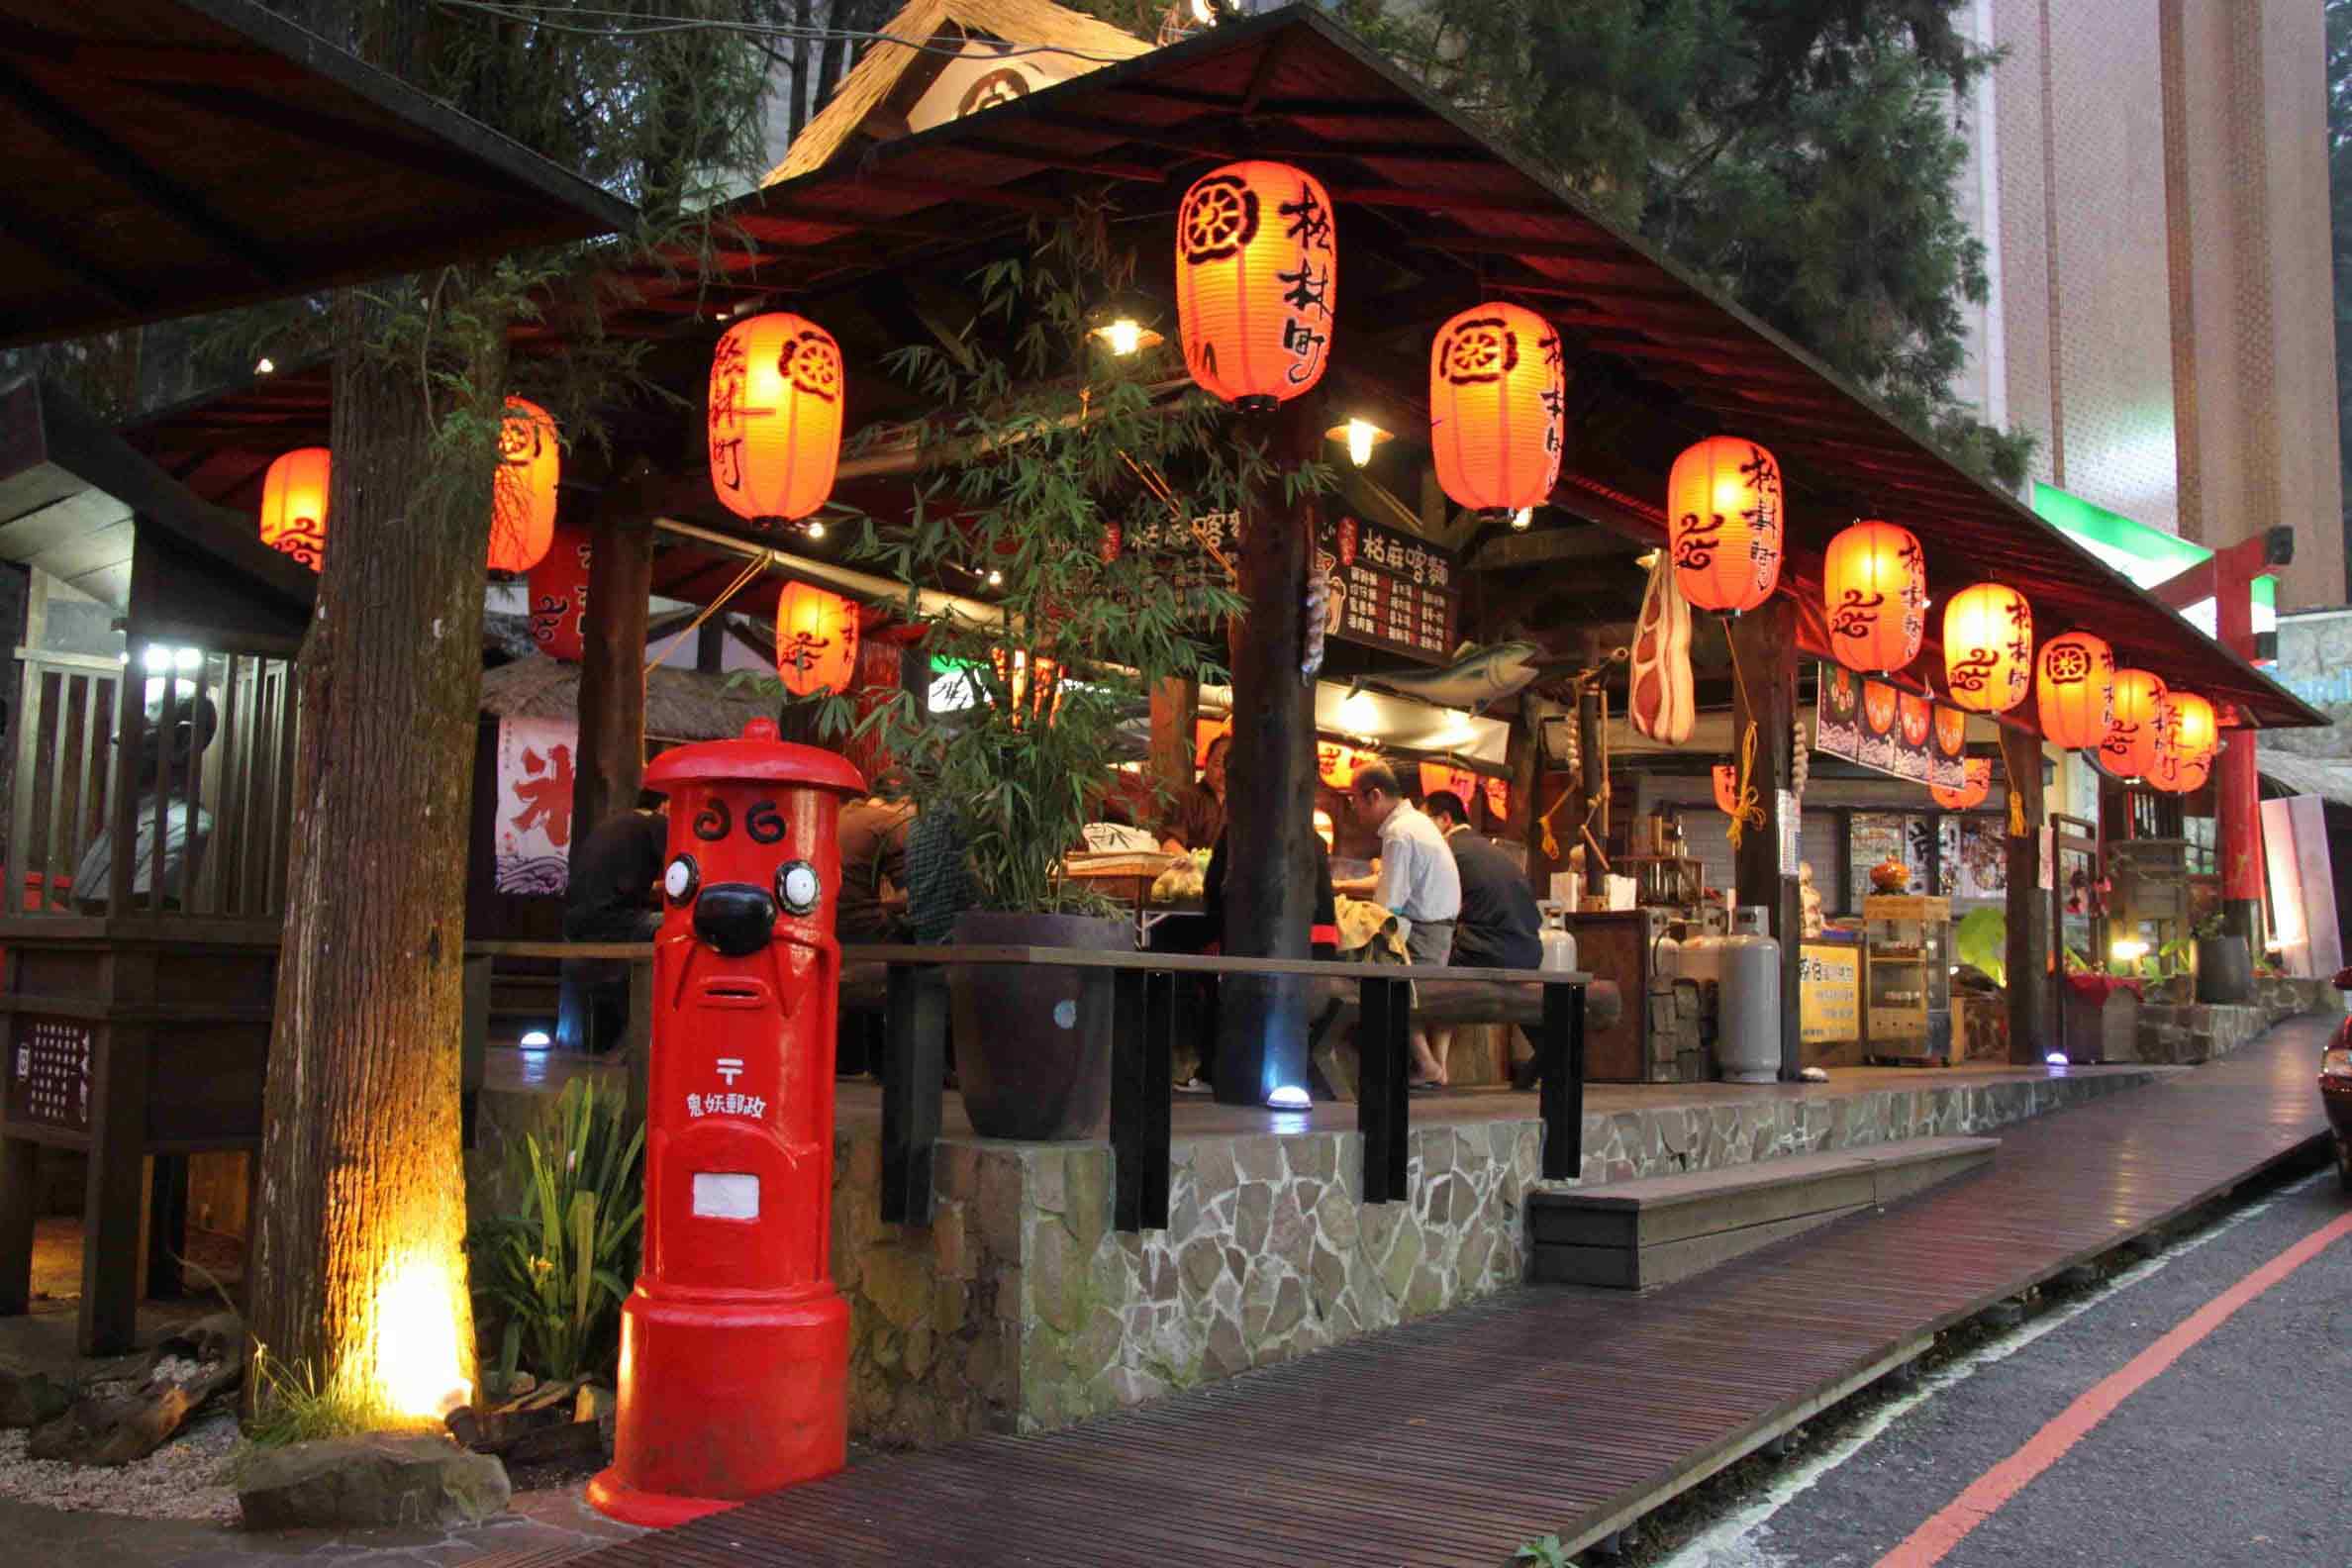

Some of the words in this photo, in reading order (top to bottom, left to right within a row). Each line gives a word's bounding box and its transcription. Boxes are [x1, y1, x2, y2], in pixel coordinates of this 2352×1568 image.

[1278, 181, 1333, 384] 松林町
[686, 1092, 767, 1120] 鬼妖郵政
